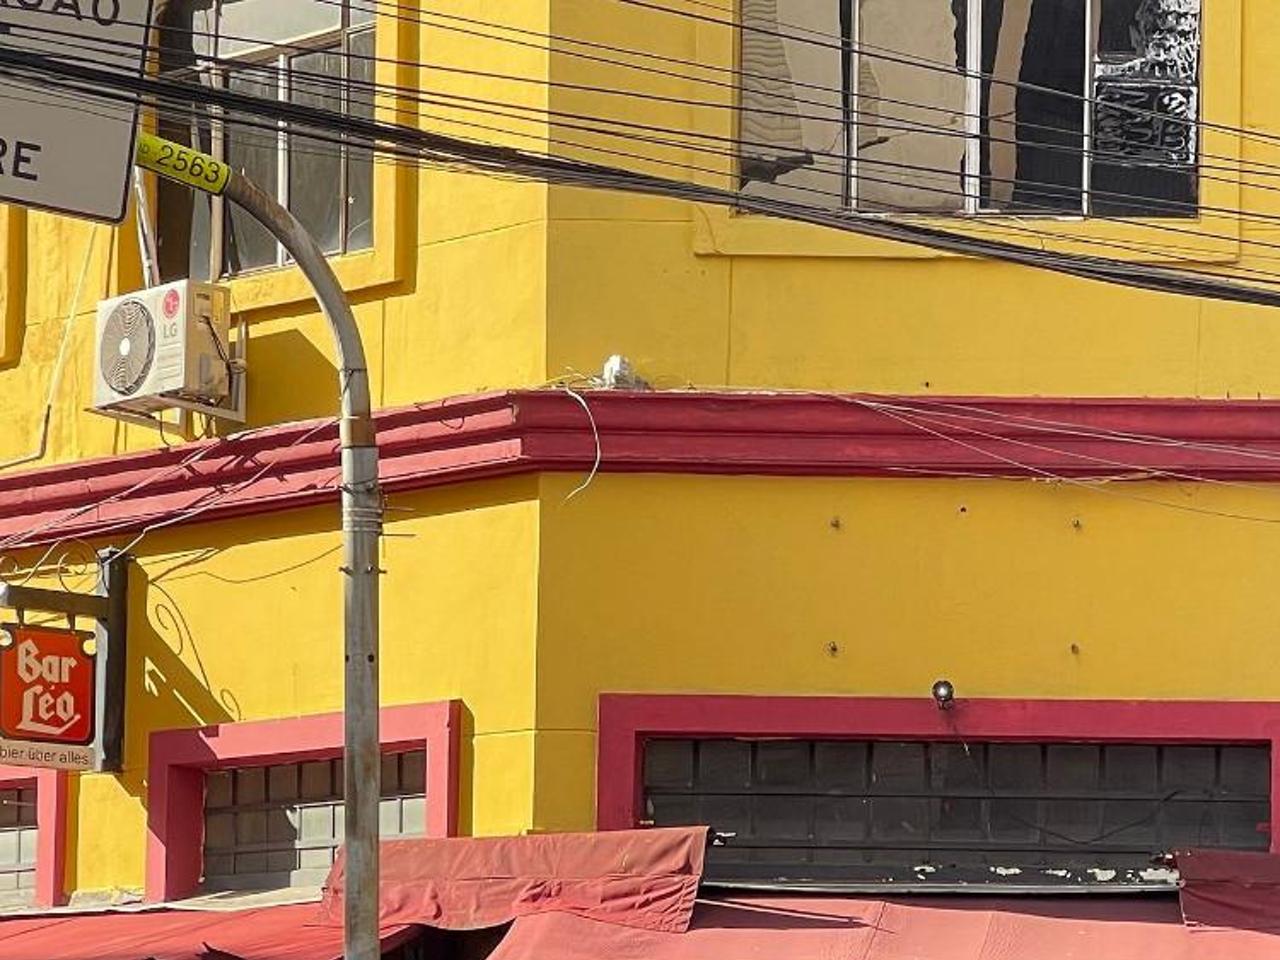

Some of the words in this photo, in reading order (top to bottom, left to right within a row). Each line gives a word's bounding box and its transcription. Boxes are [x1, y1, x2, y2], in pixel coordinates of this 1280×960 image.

[157, 145, 220, 183] 2563
[163, 323, 177, 339] LG
[17, 639, 77, 683] Bar
[28, 747, 56, 762] über
[59, 750, 89, 765] alles
